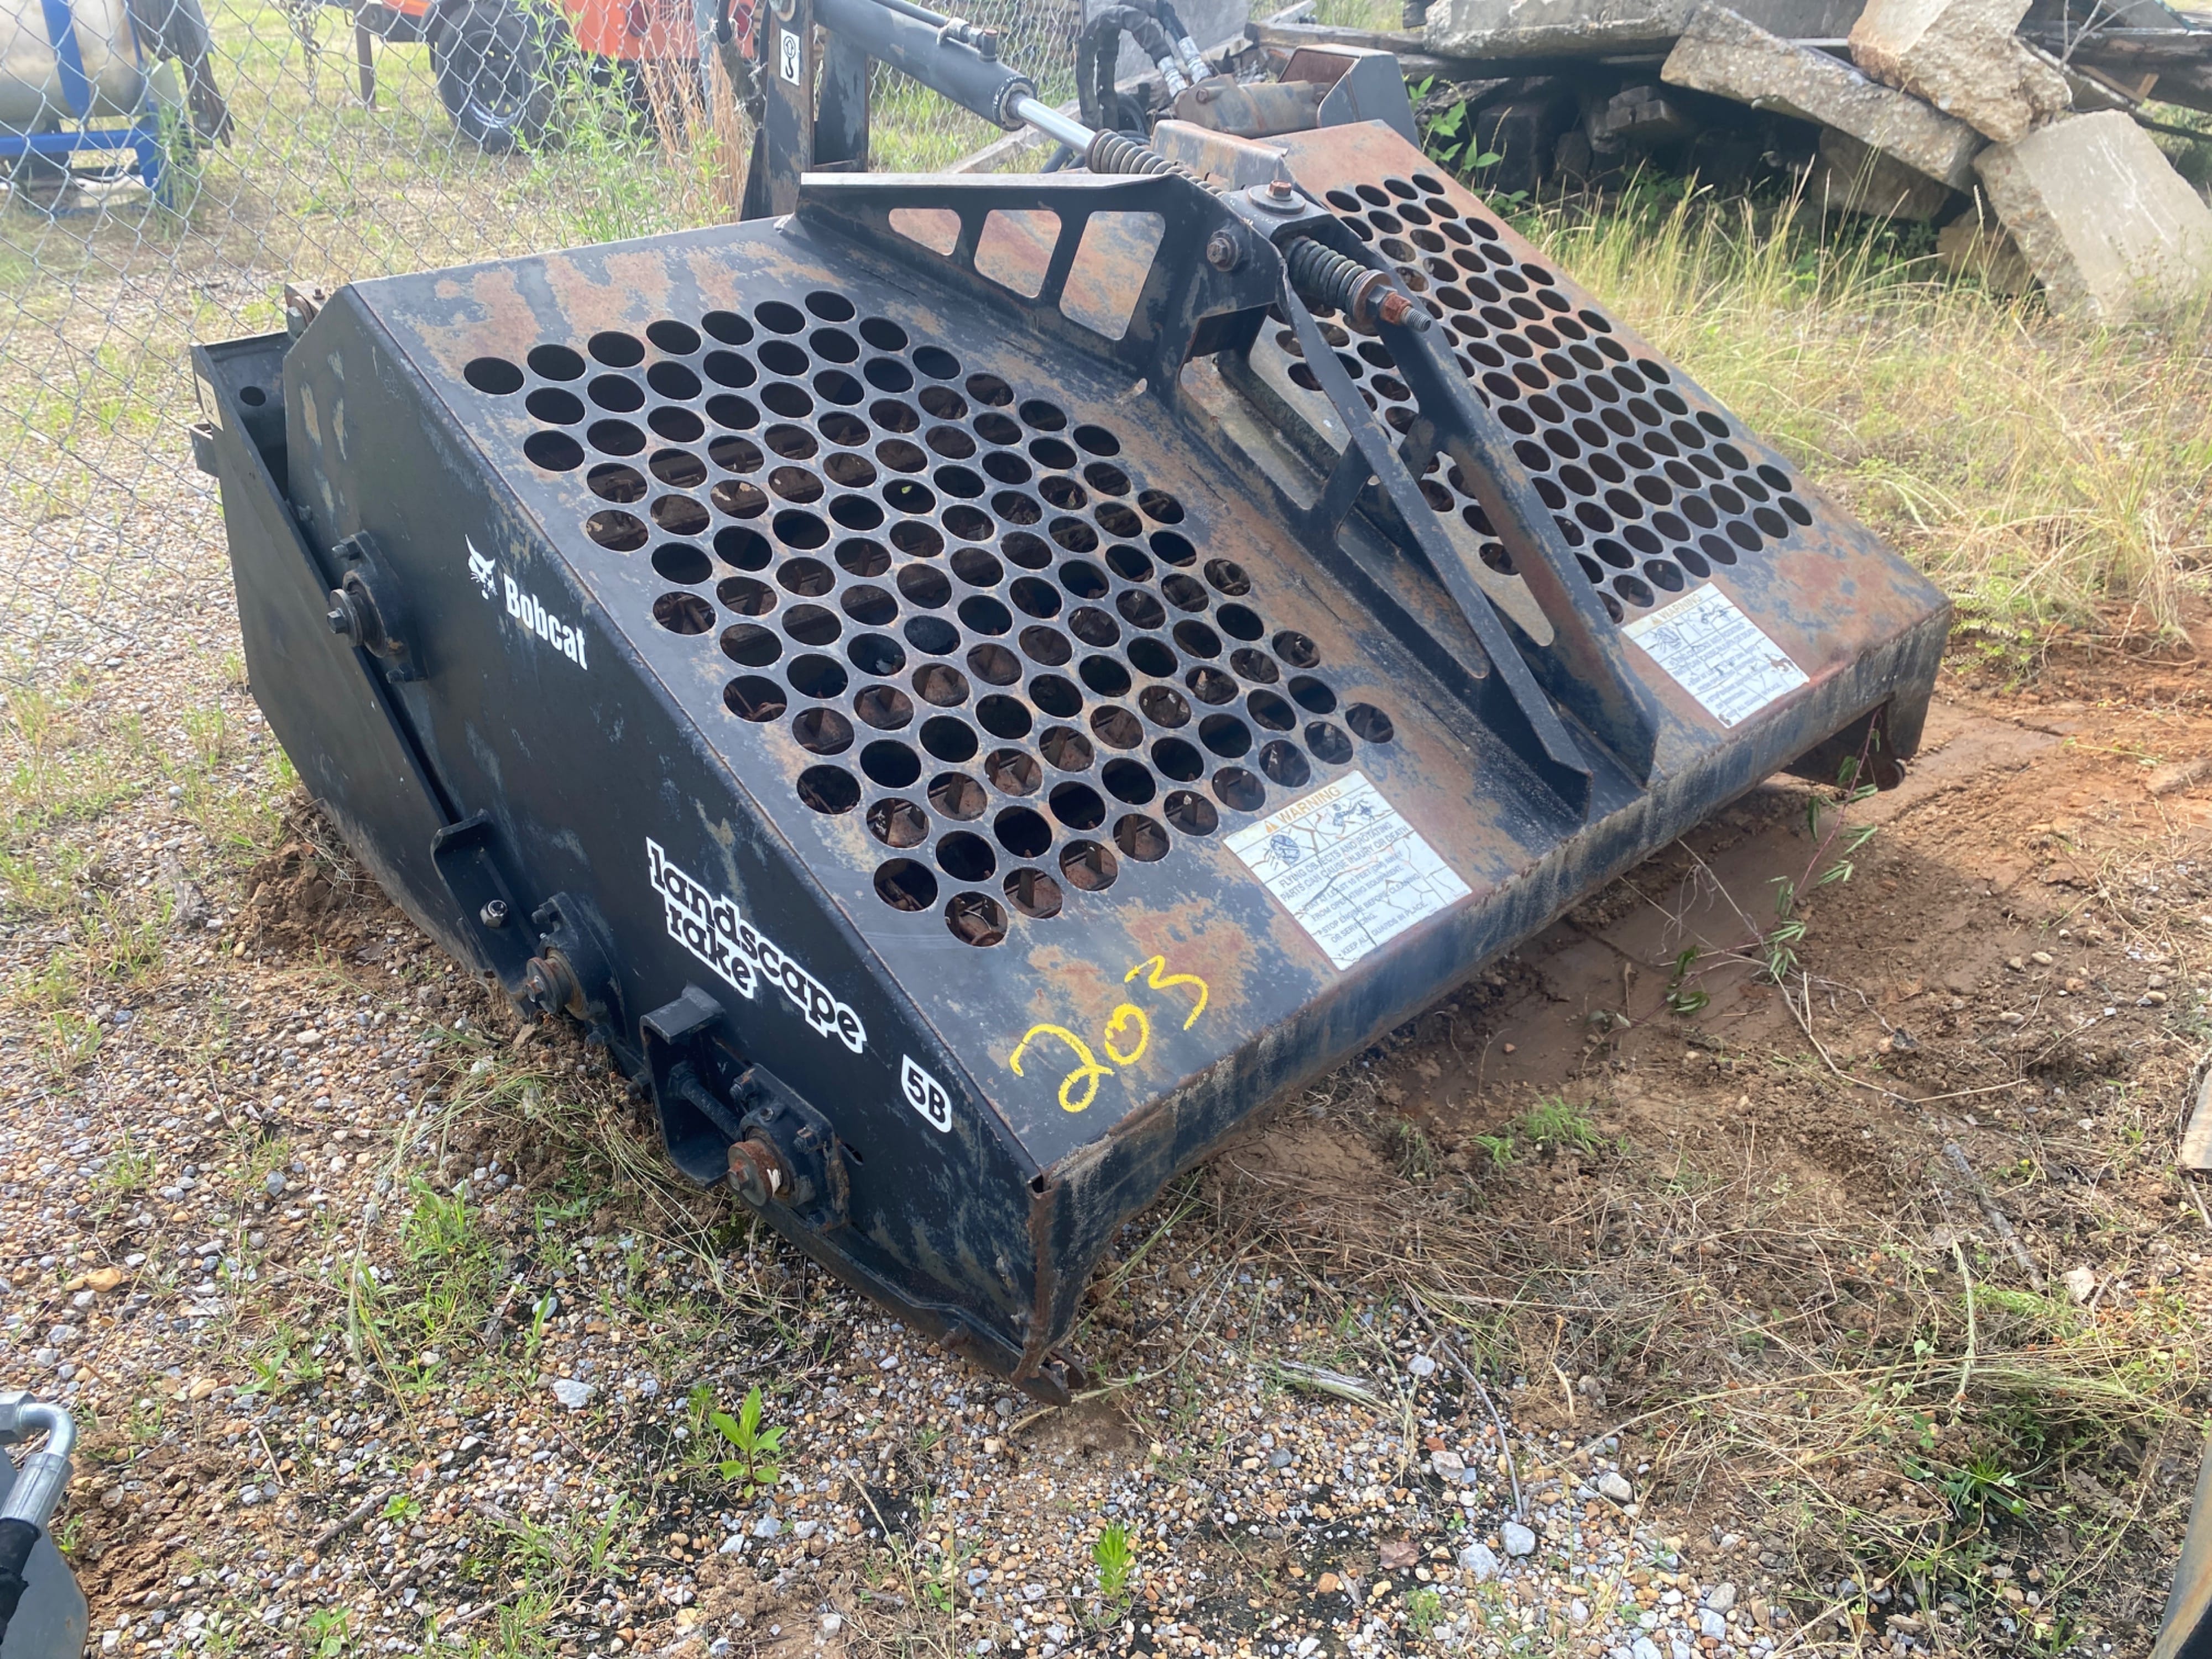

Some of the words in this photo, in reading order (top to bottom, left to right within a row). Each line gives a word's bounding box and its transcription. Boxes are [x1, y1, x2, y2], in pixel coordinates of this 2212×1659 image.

[503, 573, 587, 671] Bobcat
[1657, 592, 1703, 620] WARNING
[1275, 785, 1342, 825] WARNING
[1278, 868, 1308, 888] FLYING
[1304, 849, 1342, 873] OBJECTS
[1338, 839, 1358, 854] AND
[1355, 820, 1393, 844] ROTATING
[1280, 883, 1307, 901] PARTS
[1303, 874, 1323, 888] CAN
[1322, 859, 1349, 878] CAUSE
[1345, 844, 1375, 864] INJURY
[1373, 837, 1387, 849] OR
[1384, 825, 1410, 842] DEATH
[1301, 899, 1320, 912] STAY
[1317, 894, 1328, 902] AT
[1326, 881, 1349, 898] LEAST
[1354, 868, 1372, 881] FEET
[1384, 850, 1404, 864] AWAY
[1310, 906, 1332, 921] FROM
[1328, 885, 1368, 910] OPERATING
[1321, 919, 1341, 933] STOP
[1338, 905, 1365, 924] ENGINE
[1363, 890, 1390, 909] BEFORE
[1387, 873, 1421, 894] CLEANING
[1339, 941, 1360, 956] KEEP
[1356, 933, 1370, 945] ALL
[1370, 917, 1399, 937] GUARDS
[1396, 912, 1406, 921] IN
[647, 839, 864, 1048] landscape
[665, 899, 756, 996] rake
[1329, 932, 1343, 943] OR
[1010, 956, 1209, 1113] 203
[904, 1064, 950, 1127] 5B
